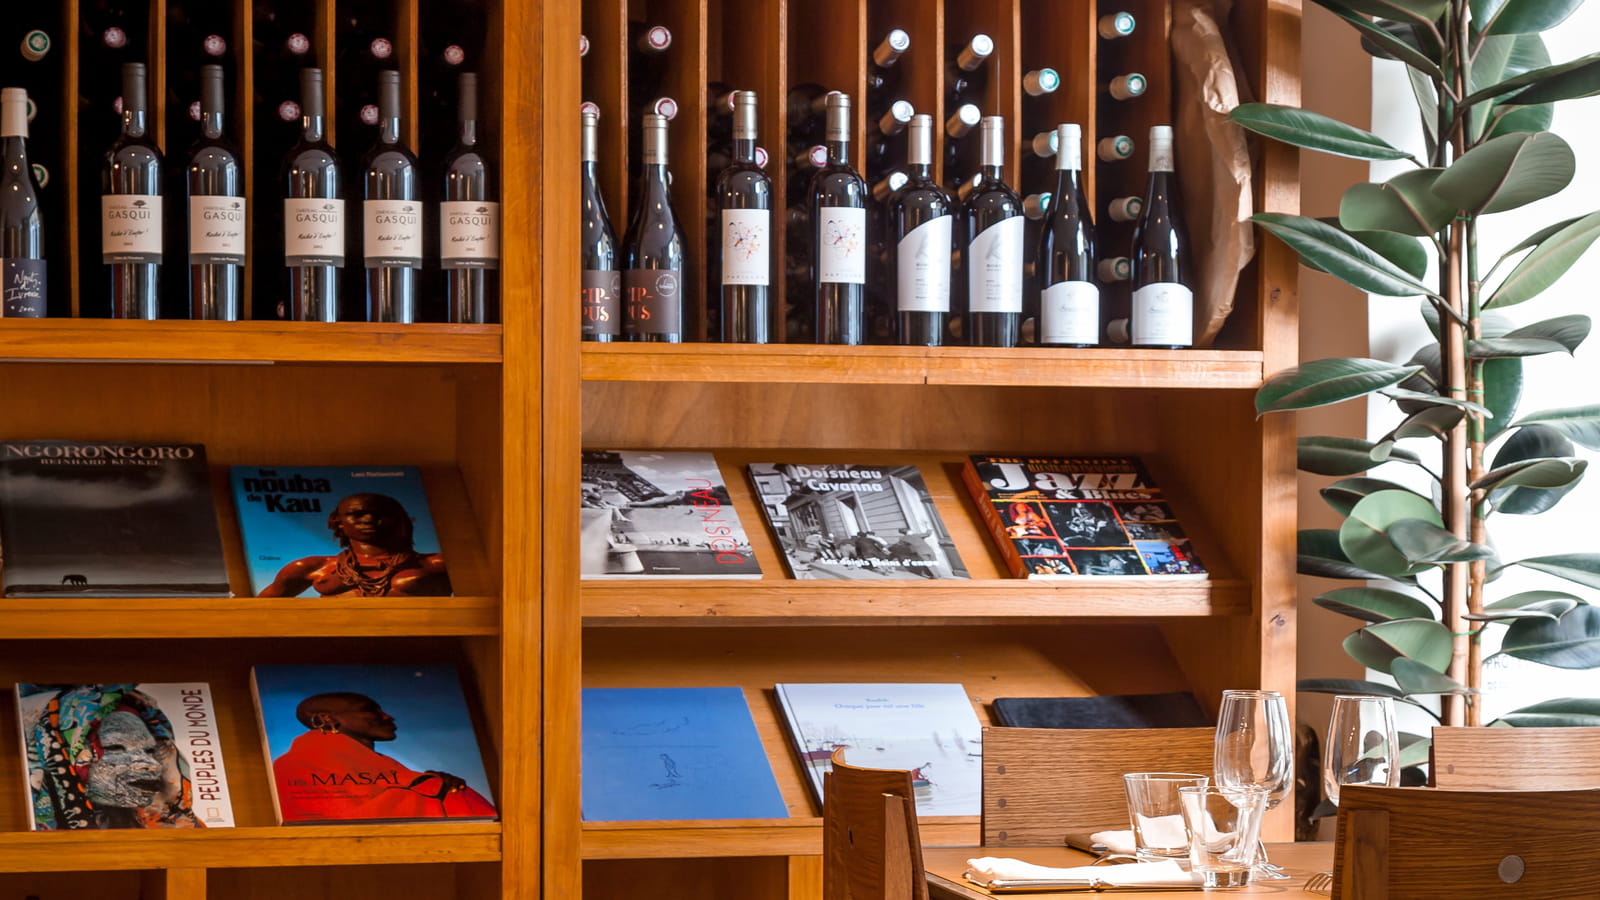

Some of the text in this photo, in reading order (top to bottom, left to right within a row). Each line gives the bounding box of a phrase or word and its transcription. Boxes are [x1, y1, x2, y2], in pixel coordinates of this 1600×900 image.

[108, 210, 151, 221] GASQUI
[296, 213, 337, 223] GASQUI
[375, 215, 417, 225] GASQUI
[449, 216, 491, 226] GASQUI
[6, 444, 194, 460] NGORONGORO
[797, 466, 882, 479] Doisneau
[989, 462, 1146, 490] Jazz
[244, 474, 332, 493] nouba
[807, 479, 883, 492] Cavanna
[1055, 489, 1079, 499] &
[1083, 489, 1152, 499] Blues
[247, 494, 321, 512] de Kau
[180, 688, 209, 727] MONDE
[189, 730, 213, 747] DU
[191, 750, 222, 801] PEUPLES
[311, 770, 400, 786] MASAÏ
